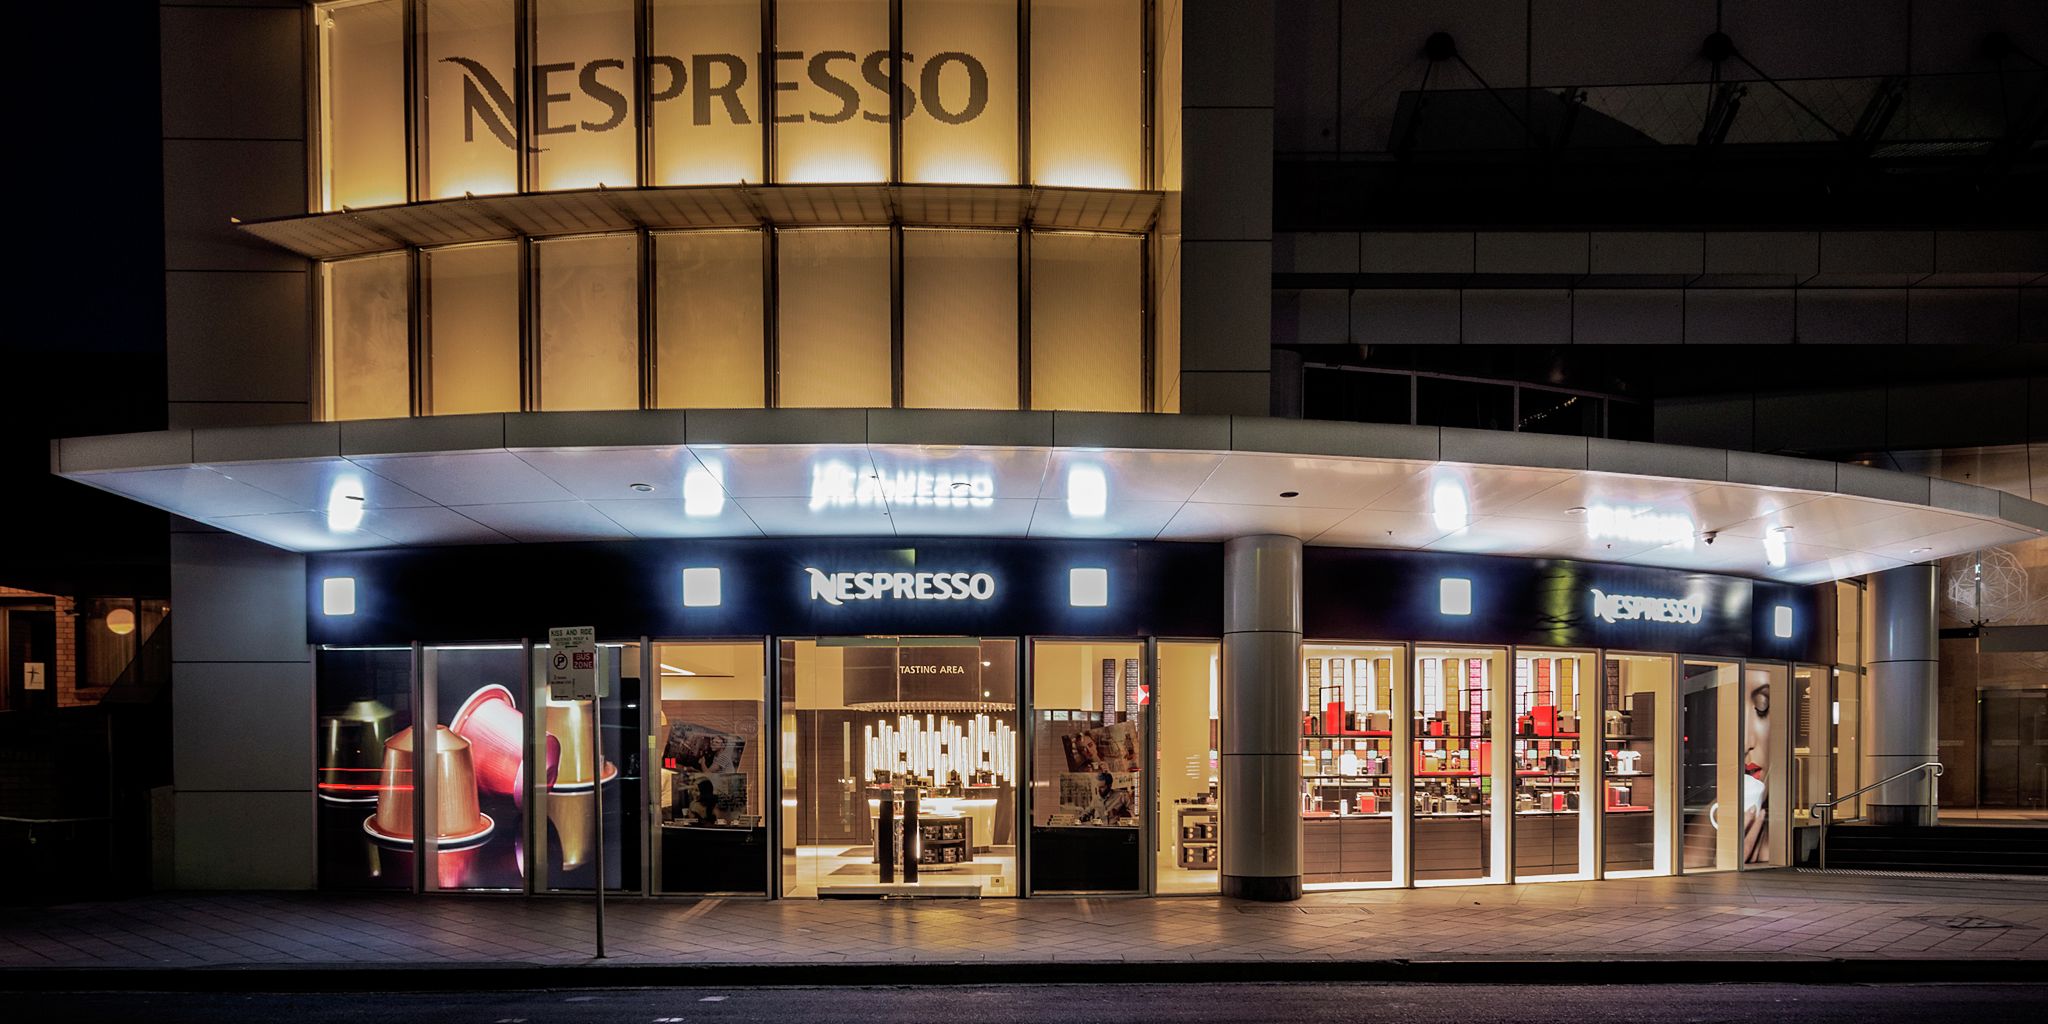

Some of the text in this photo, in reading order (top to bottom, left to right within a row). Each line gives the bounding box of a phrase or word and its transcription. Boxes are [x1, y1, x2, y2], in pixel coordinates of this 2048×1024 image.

[438, 50, 989, 153] NESPRESSO
[804, 567, 995, 606] NESPRESSO
[1590, 588, 1703, 625] NESPRESSO
[900, 665, 965, 674] TASTING AREA
